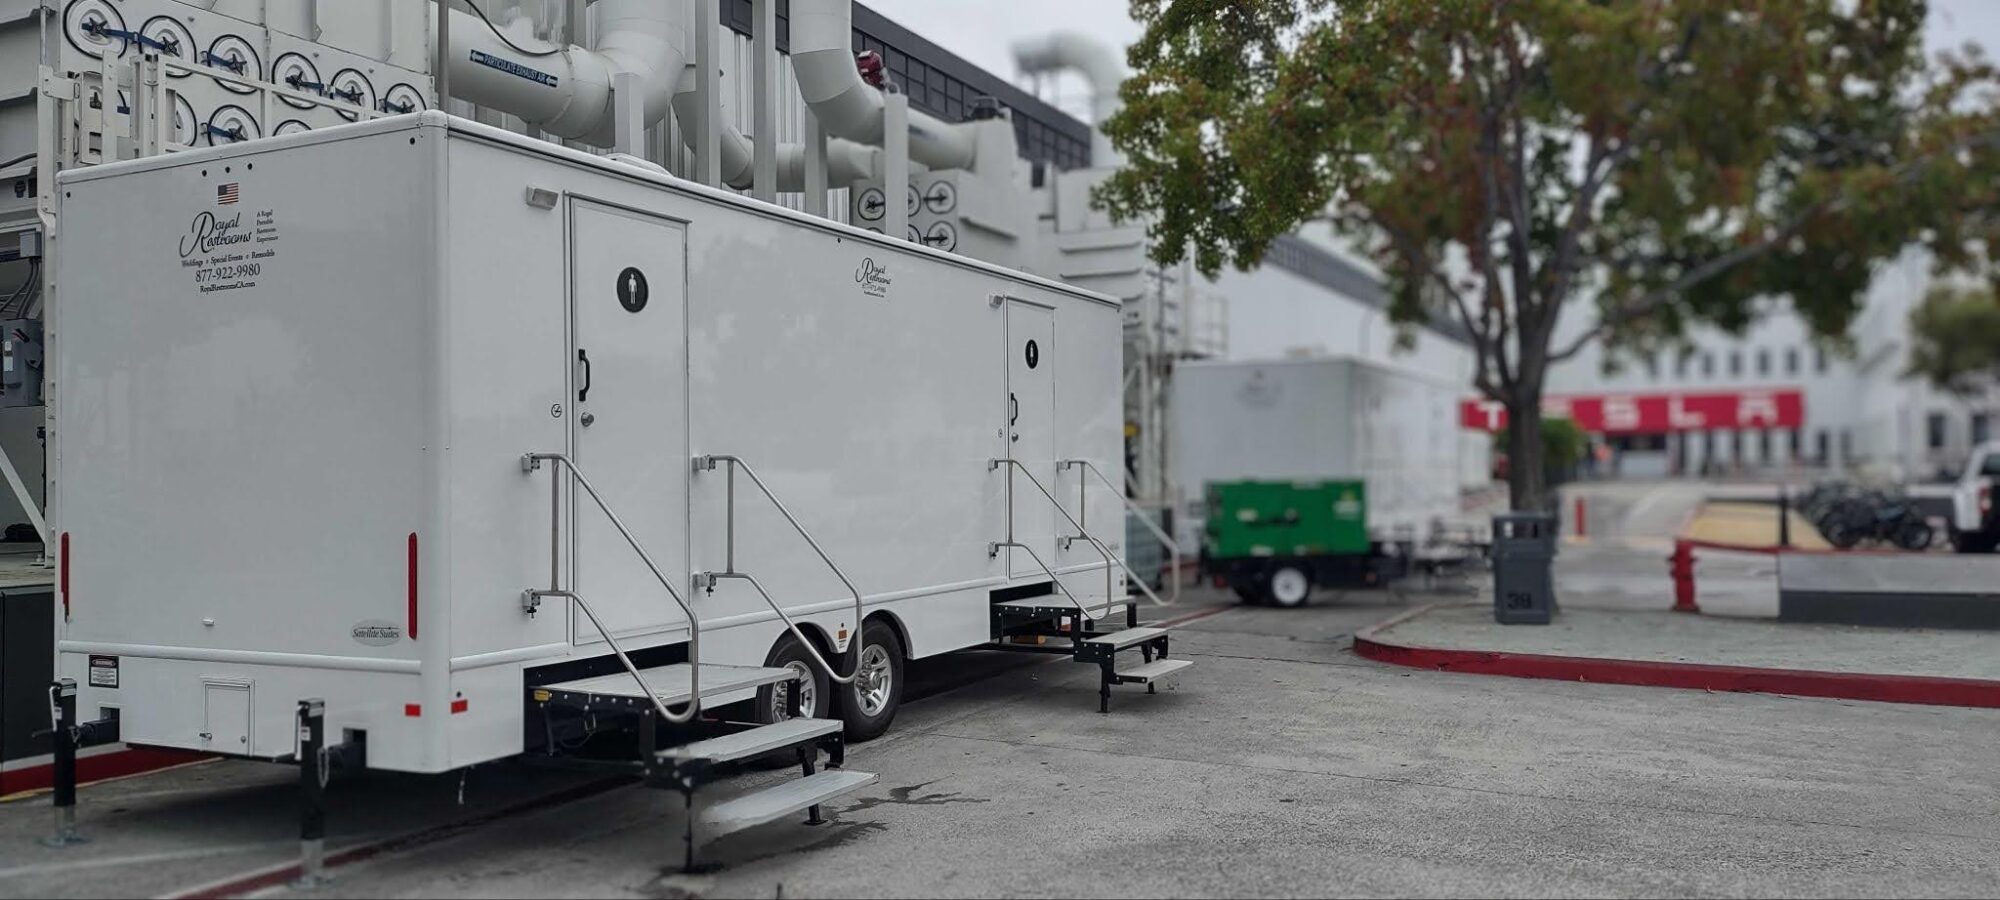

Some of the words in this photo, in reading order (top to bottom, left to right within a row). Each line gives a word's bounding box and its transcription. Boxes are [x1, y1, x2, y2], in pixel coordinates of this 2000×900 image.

[483, 54, 517, 73] PARTICULATE
[517, 64, 537, 80] EXHAUST
[537, 72, 547, 83] AIR
[179, 211, 241, 258] Royal
[200, 230, 252, 253] Restrooms
[210, 255, 227, 266] Special
[228, 253, 243, 262] Events
[251, 249, 275, 259] Remodels
[195, 263, 261, 283] 877-922-9980
[855, 257, 886, 282] Royal
[352, 628, 379, 639] Satellite
[380, 629, 400, 639] Suites
